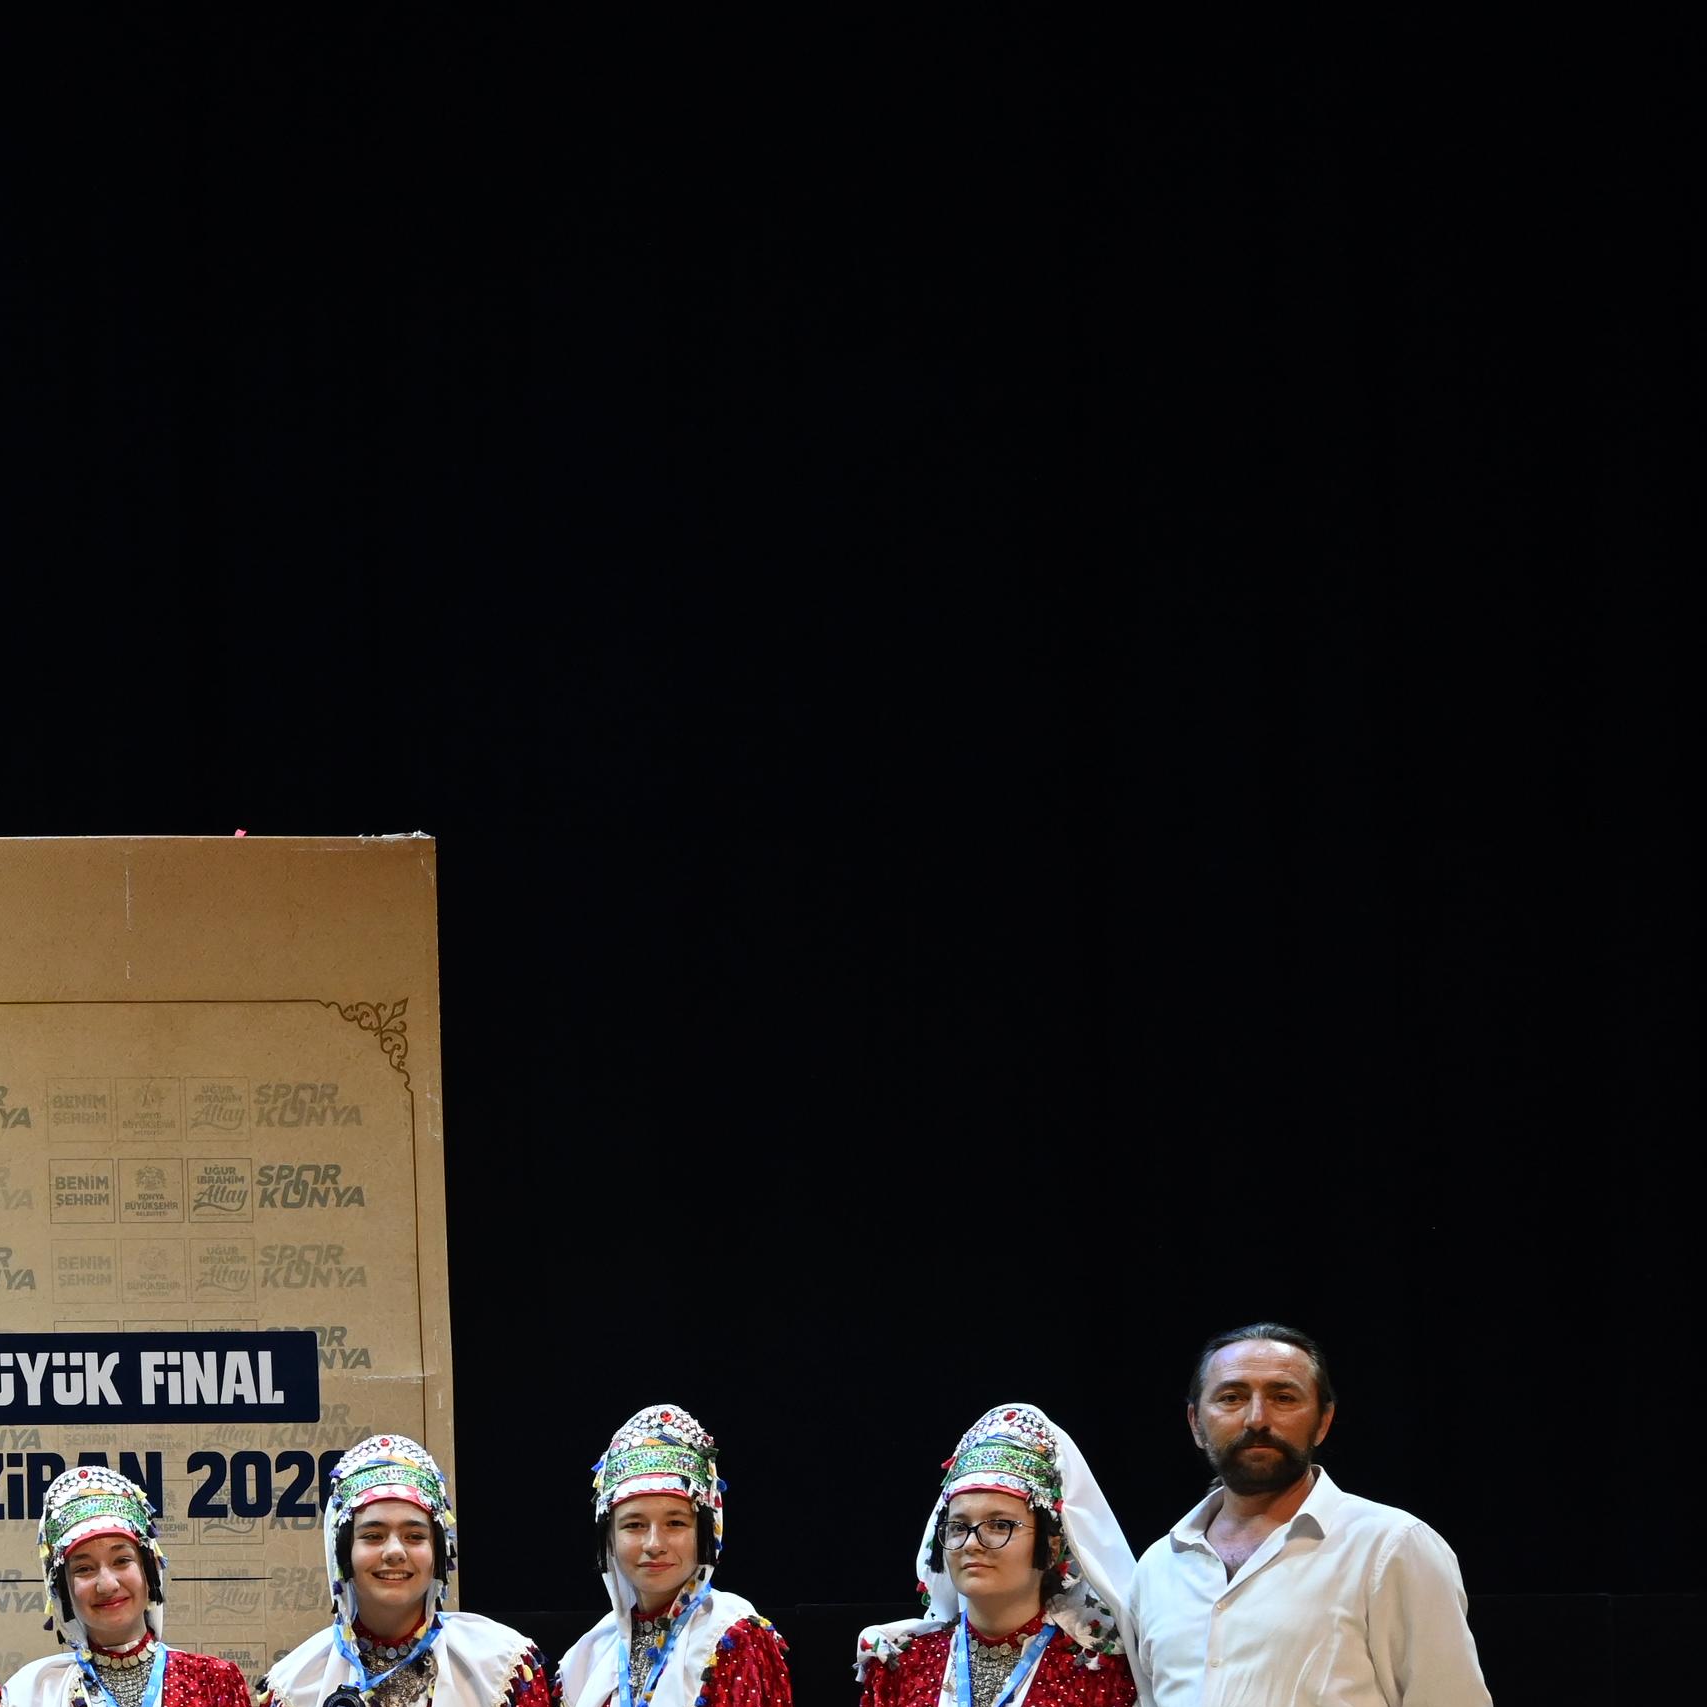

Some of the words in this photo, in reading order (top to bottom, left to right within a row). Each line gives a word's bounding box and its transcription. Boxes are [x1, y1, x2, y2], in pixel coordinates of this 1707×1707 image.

[254, 1083, 339, 1112] SPOR
[256, 1098, 363, 1127] KONYA
[204, 1165, 236, 1175] UĞUR
[255, 1164, 342, 1193] SPOR
[193, 1184, 248, 1212] Altay
[258, 1180, 365, 1209] KONYA
[257, 1244, 344, 1274] SPOR
[195, 1264, 251, 1292] Altay
[259, 1260, 368, 1289] KONYA
[318, 1348, 372, 1369] NYA
[140, 1350, 284, 1406] FİNAL
